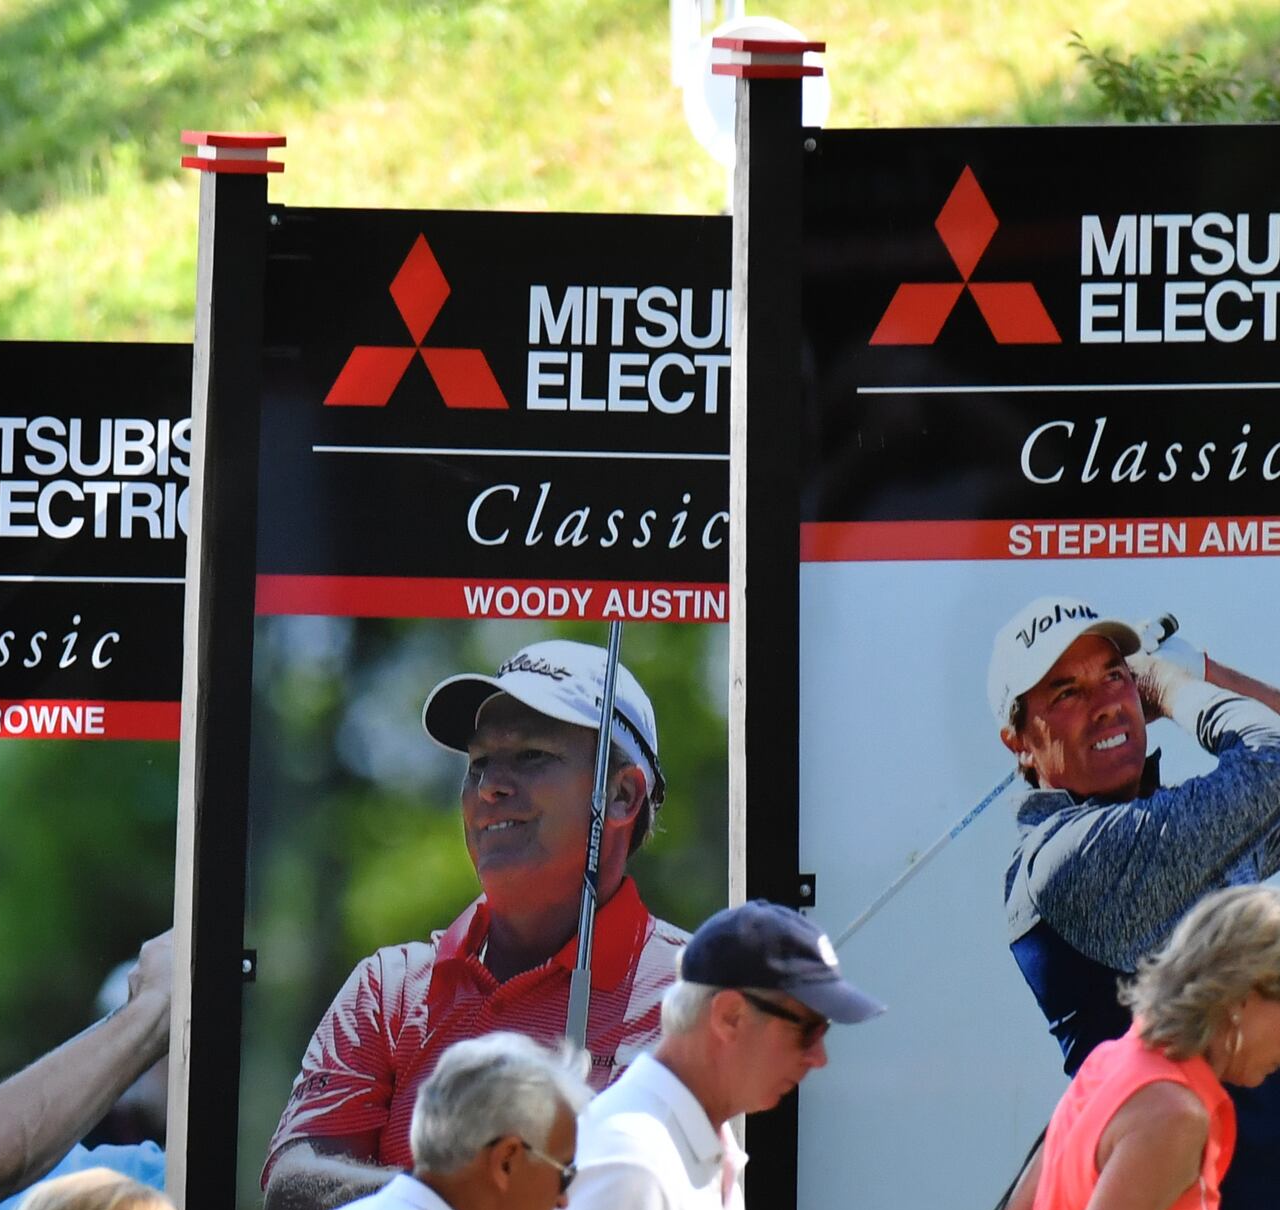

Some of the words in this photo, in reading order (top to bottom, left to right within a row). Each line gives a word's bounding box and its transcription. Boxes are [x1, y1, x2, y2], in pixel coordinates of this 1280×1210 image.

[528, 284, 732, 349] MITSU
[527, 351, 731, 415] ELECT
[466, 482, 730, 549] Classic
[1008, 522, 1187, 555] STEPHEN
[464, 585, 593, 617] WOODY
[602, 587, 726, 619] AUSTIN
